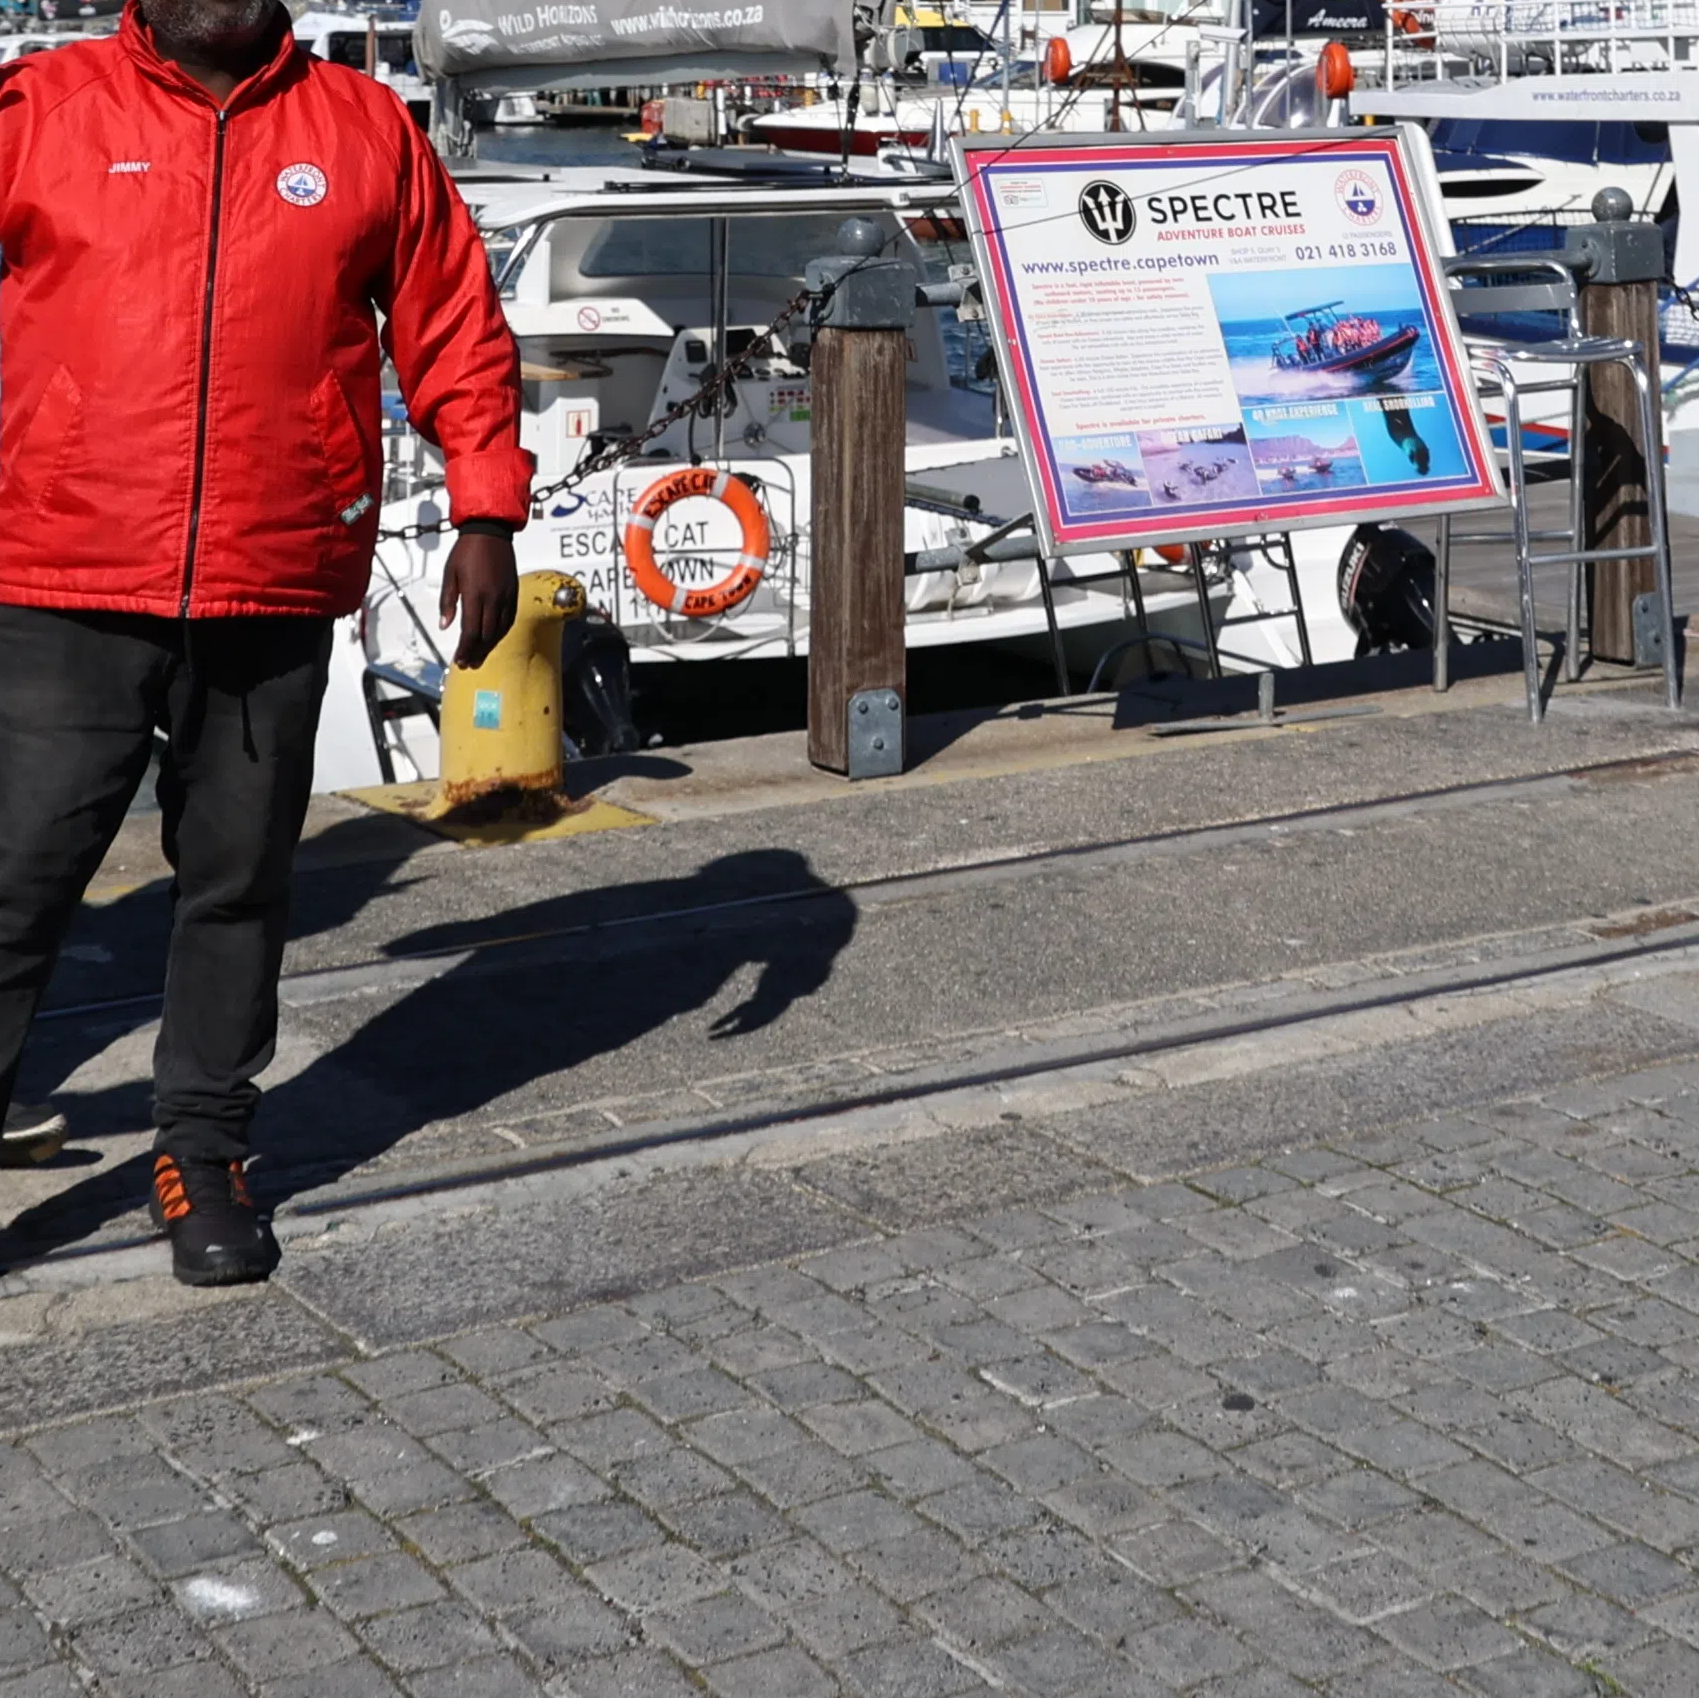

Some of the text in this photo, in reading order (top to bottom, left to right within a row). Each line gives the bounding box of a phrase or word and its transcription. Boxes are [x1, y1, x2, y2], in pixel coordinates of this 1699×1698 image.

[497, 4, 599, 36] WILD HORIZONS
[1307, 8, 1368, 29] Ameera
[1531, 88, 1681, 103] www.waterfrontcharters.co.za
[108, 161, 151, 174] JIMMY
[1147, 190, 1302, 224] SPECTRE
[1157, 223, 1306, 242] ADVENTURE BOAT CRUISES
[1295, 241, 1397, 261] 021 418 3168
[1022, 253, 1220, 277] www.spectre.capetown
[559, 521, 709, 558] ESCA CAT
[659, 557, 715, 583] OWN
[684, 595, 717, 610] CAPE
